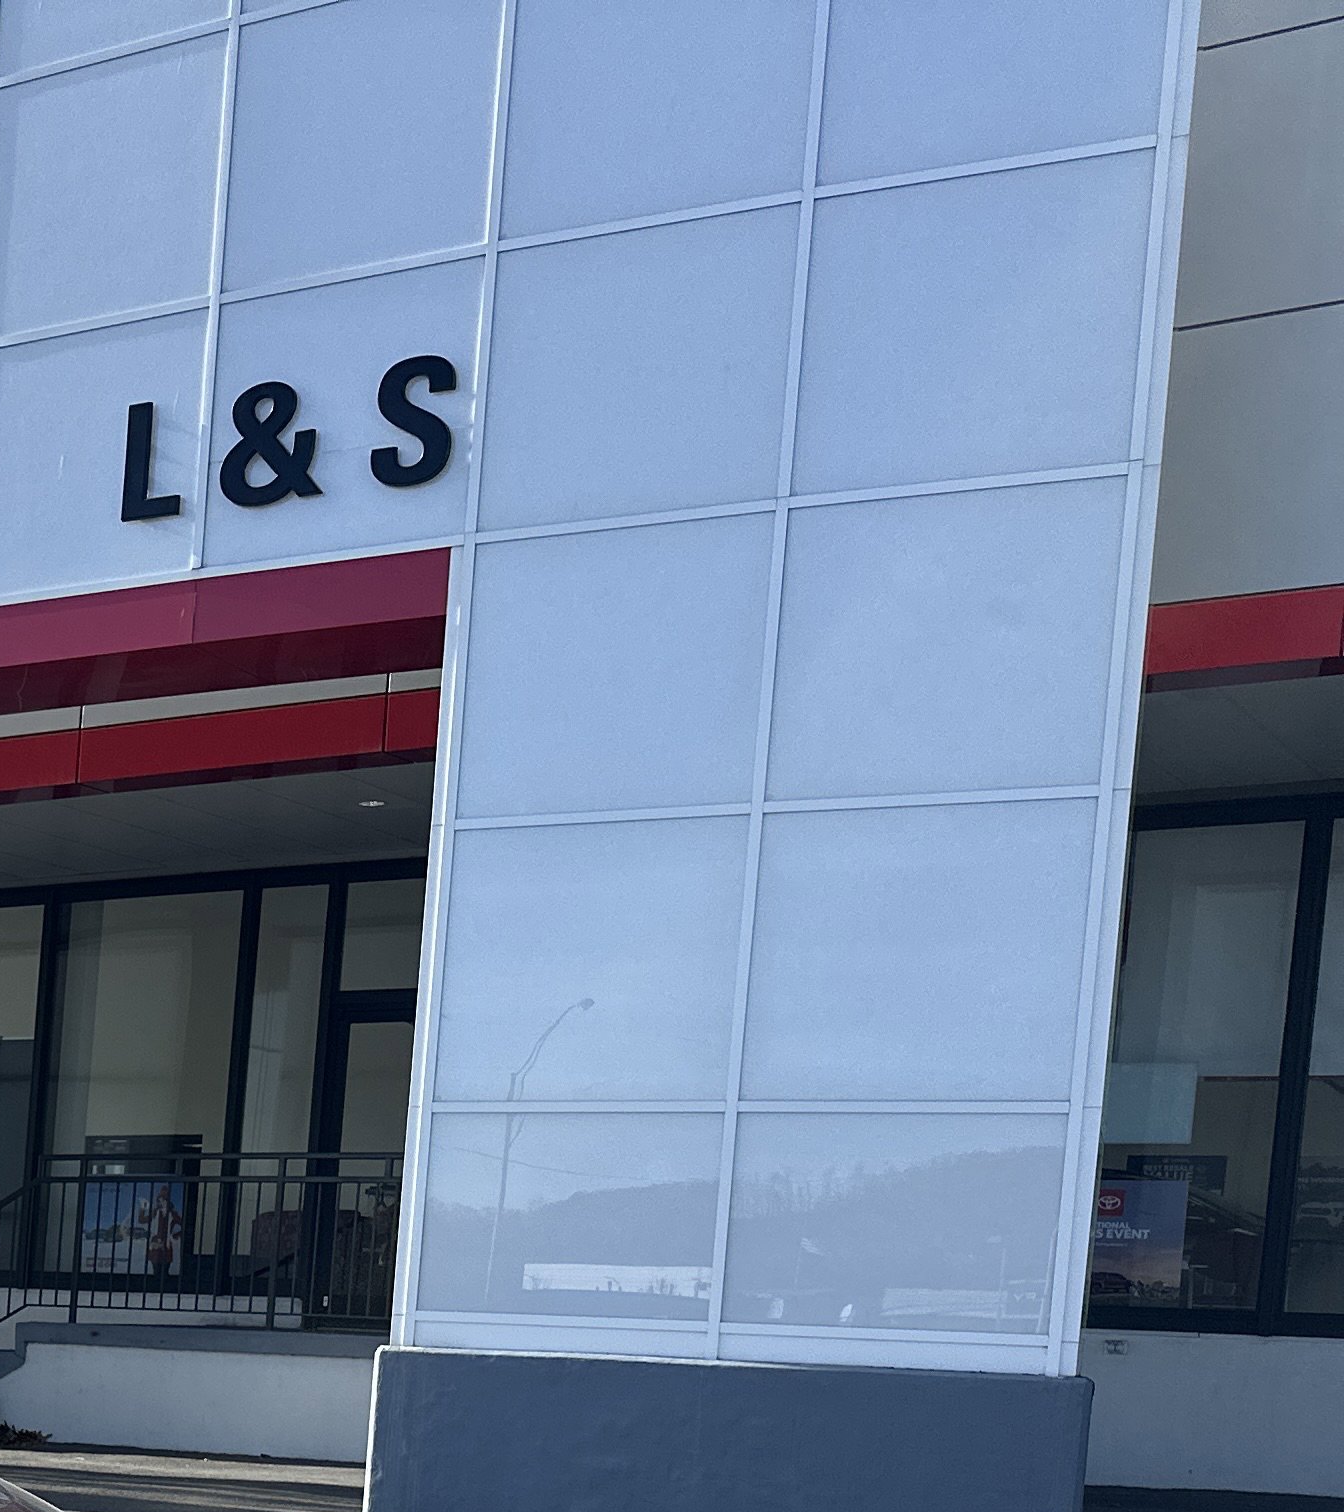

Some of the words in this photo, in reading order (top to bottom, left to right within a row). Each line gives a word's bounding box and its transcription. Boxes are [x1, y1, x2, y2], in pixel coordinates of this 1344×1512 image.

[120, 401, 181, 522] L
[219, 381, 323, 507] &
[370, 354, 457, 487] S
[1097, 1221, 1130, 1230] TIONAL
[1105, 1228, 1151, 1240] EVENT
